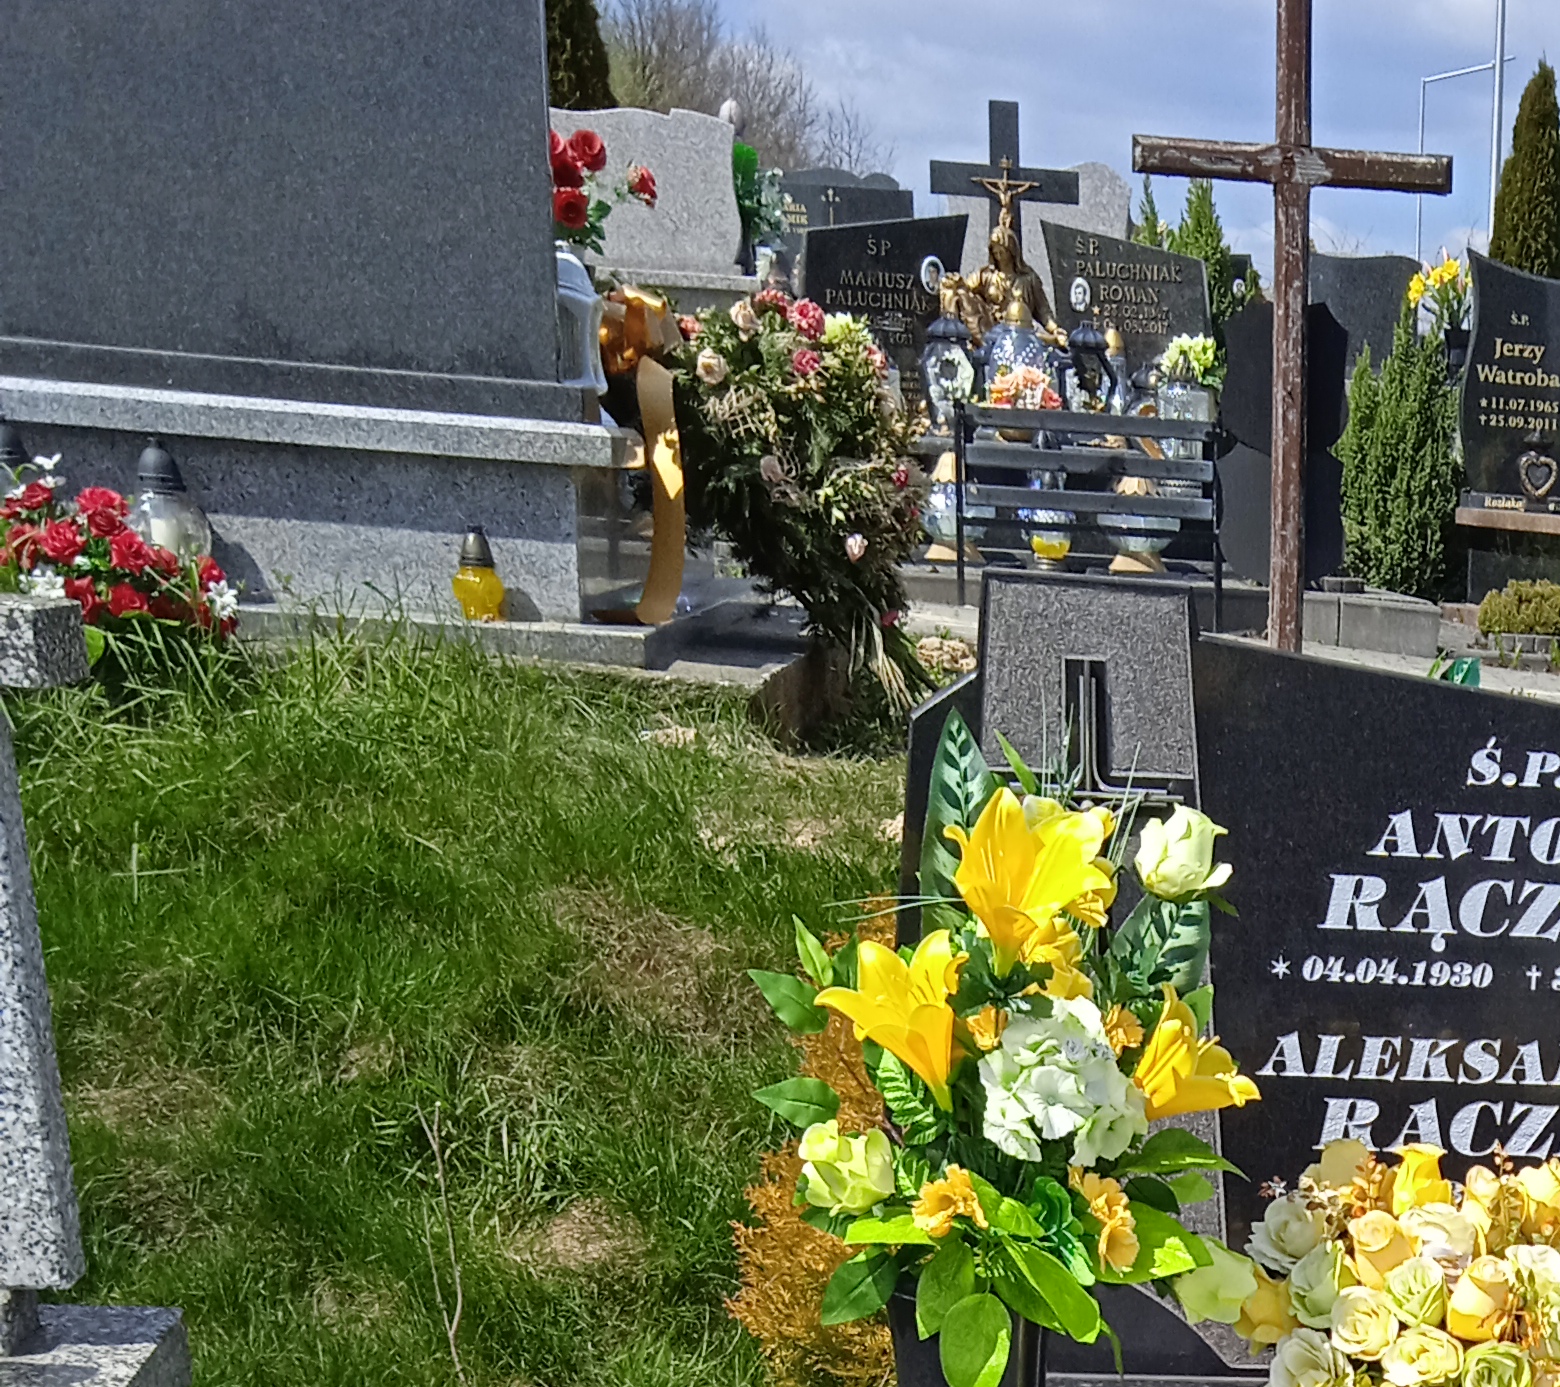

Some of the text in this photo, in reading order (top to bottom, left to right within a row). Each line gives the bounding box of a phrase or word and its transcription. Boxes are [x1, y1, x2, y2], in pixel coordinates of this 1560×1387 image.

[840, 270, 914, 290] MARIUSZ
[1076, 260, 1182, 282] PALUCHNIAK
[1100, 285, 1160, 303] ROMAN
[1510, 310, 1530, 326] Ś.P.
[1494, 337, 1546, 365] Jerzy
[1476, 363, 1560, 388] Watroba
[1491, 396, 1560, 414] 11.07.1965
[1489, 413, 1558, 431] 25.09.2011
[1302, 954, 1494, 990] 04.04.1930
